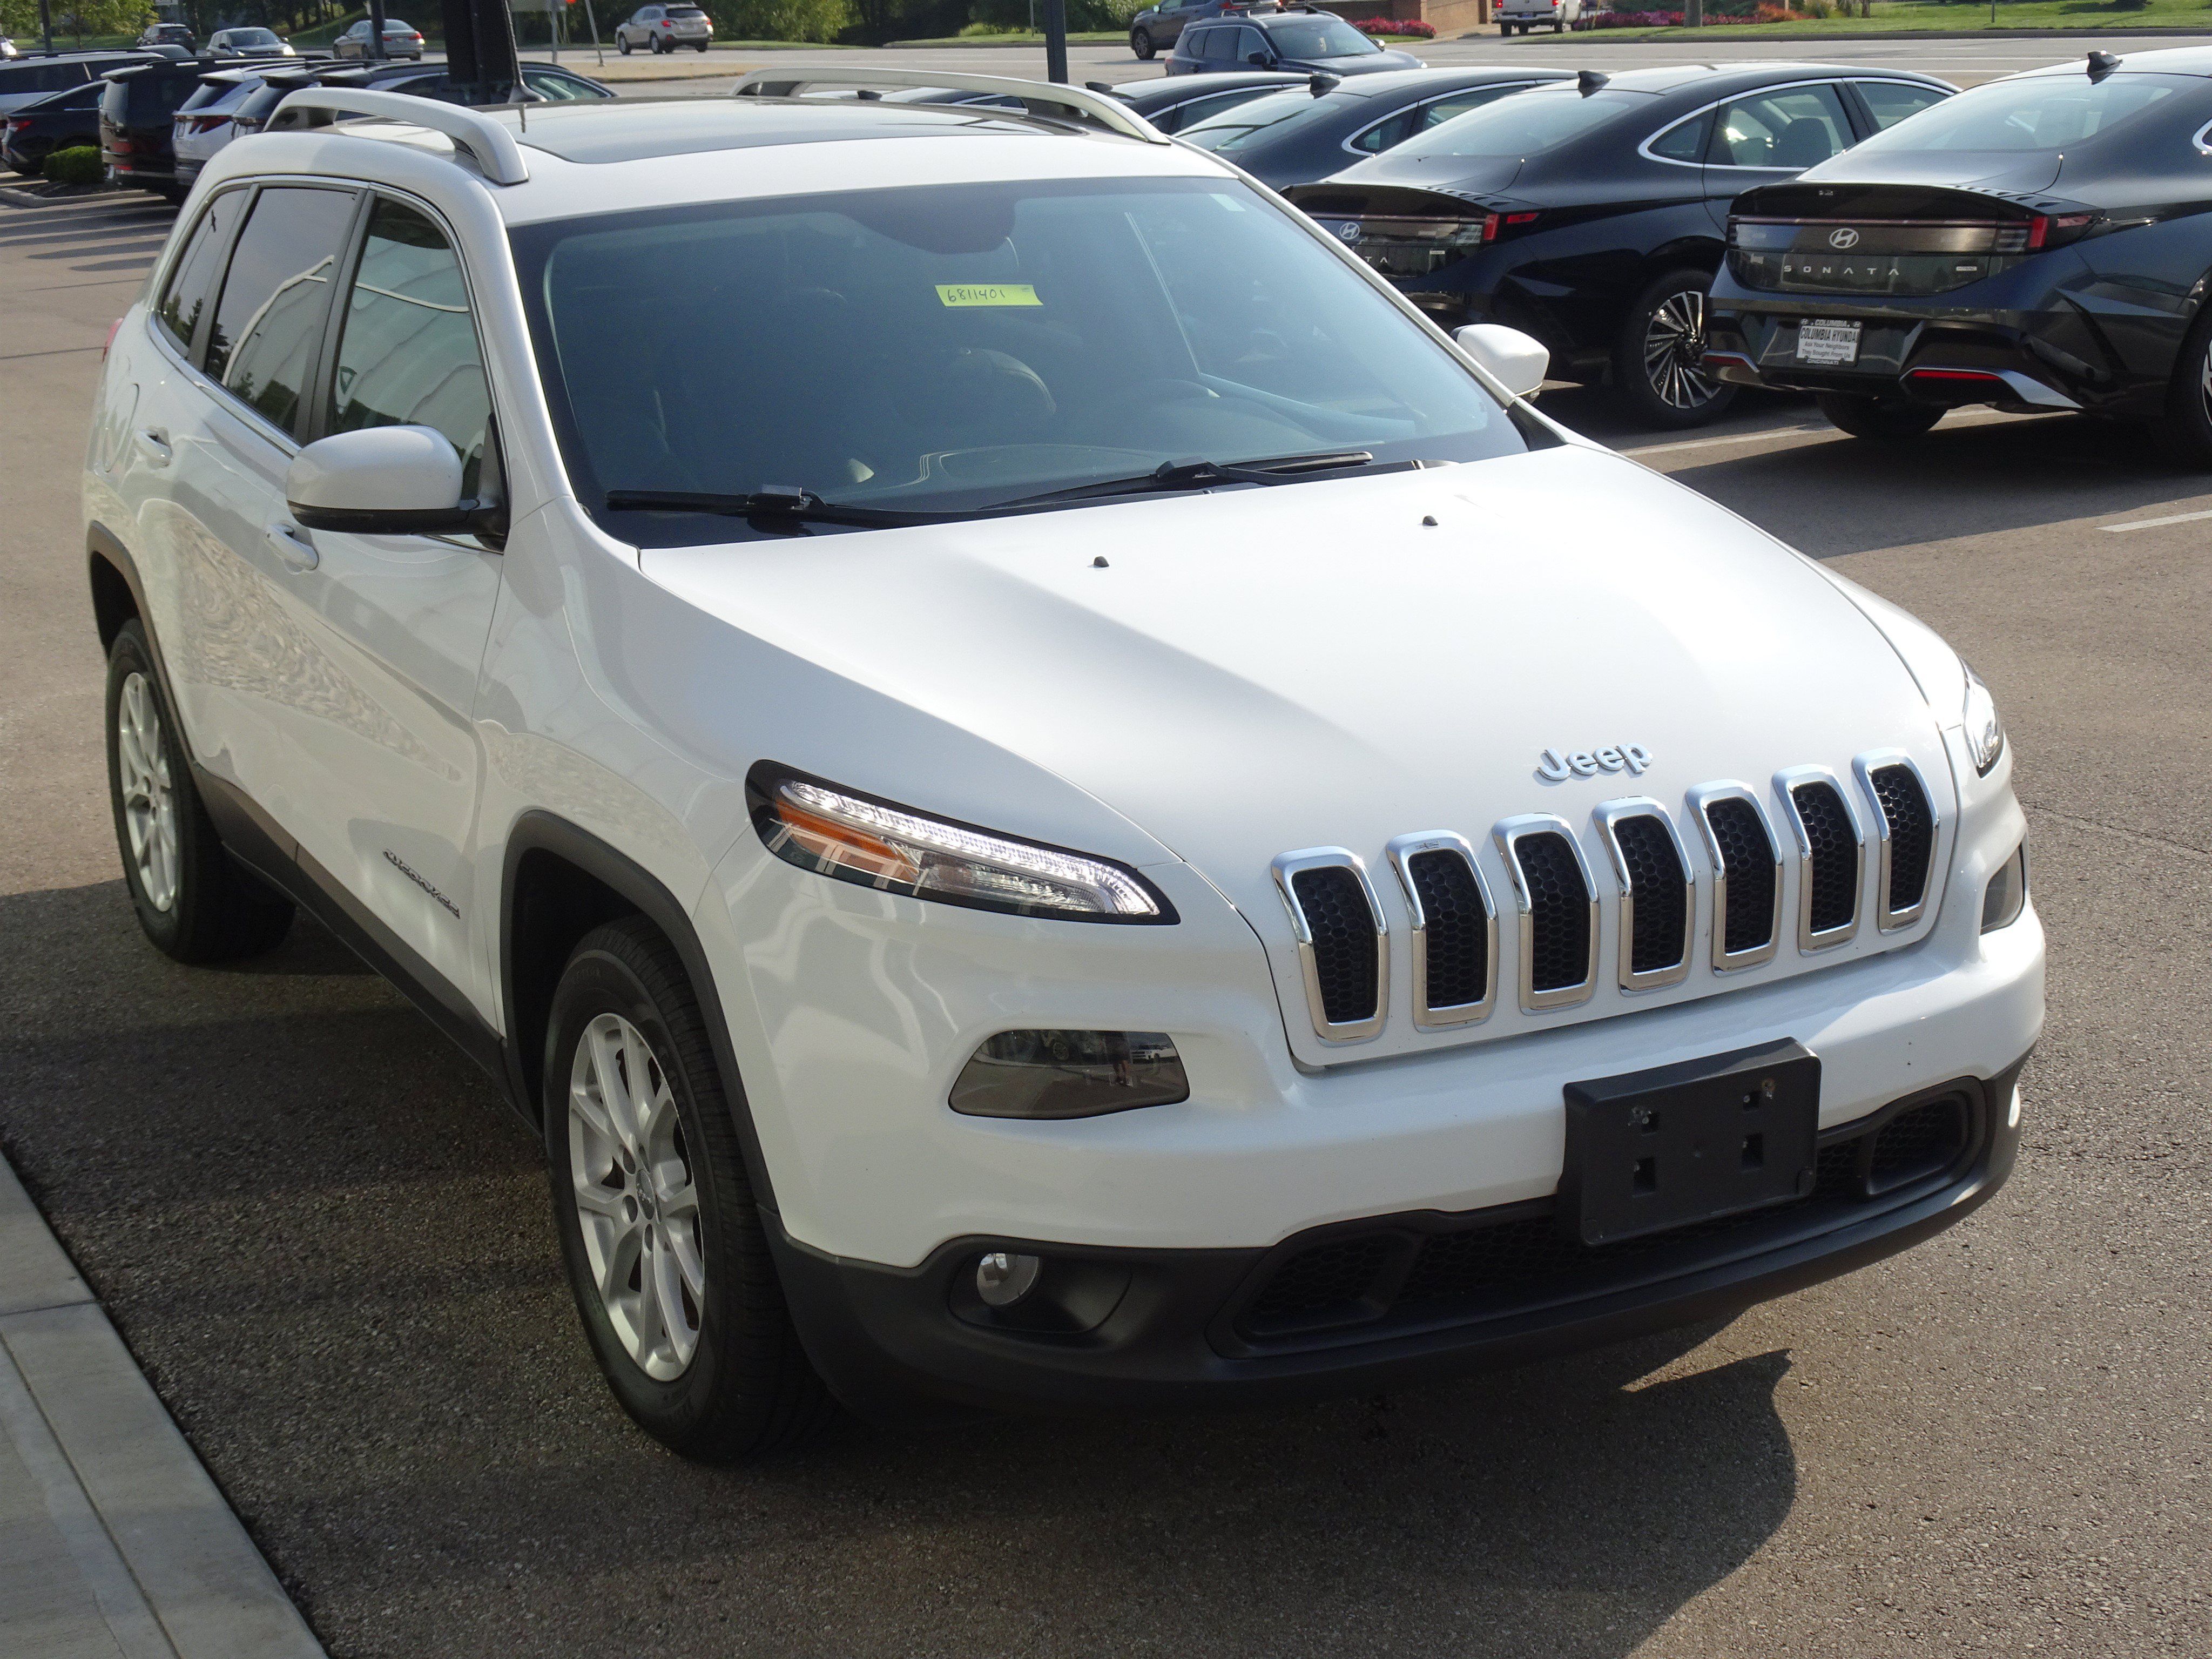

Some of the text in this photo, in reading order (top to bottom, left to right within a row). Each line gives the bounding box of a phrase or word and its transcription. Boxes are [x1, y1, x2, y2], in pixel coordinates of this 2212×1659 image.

[1783, 265, 1899, 275] SONATA
[947, 288, 1006, 302] 6811401
[1800, 328, 1831, 341] COLUMBIA
[1537, 742, 1653, 781] Jeep
